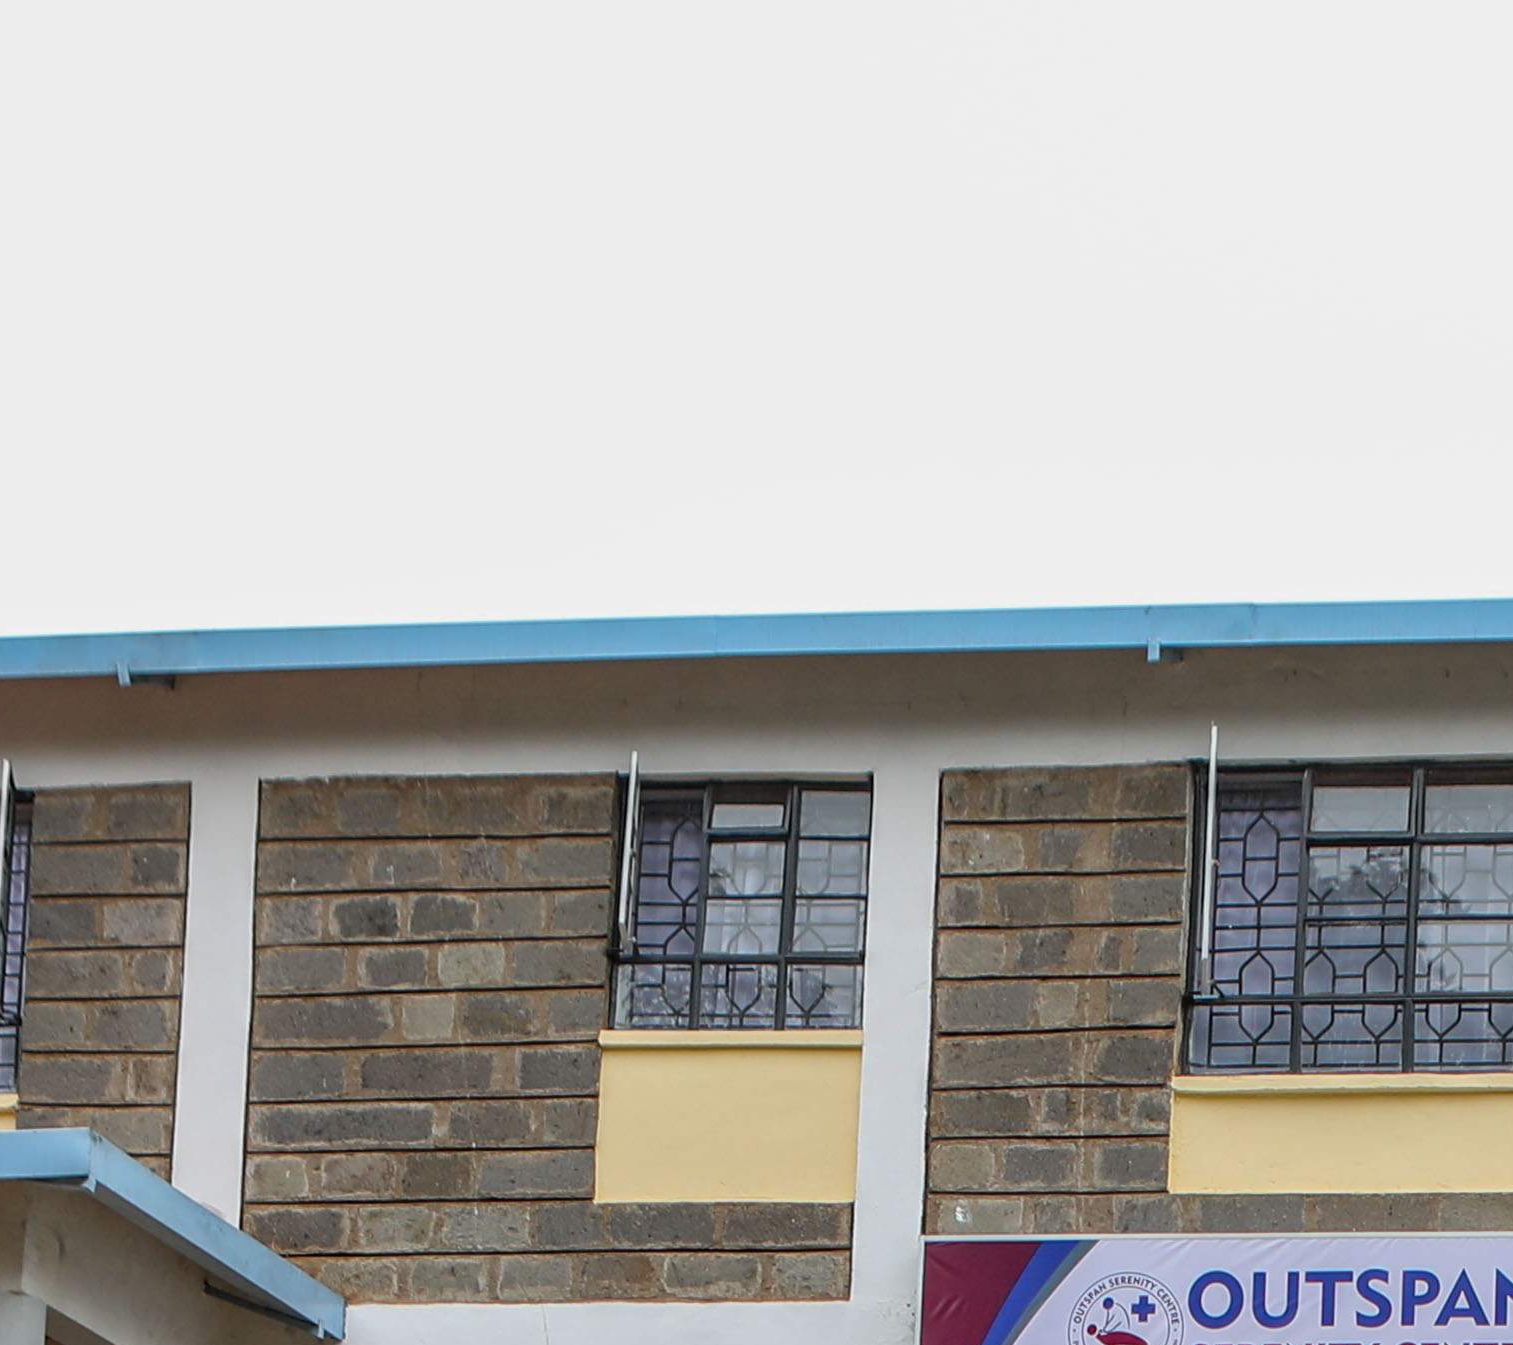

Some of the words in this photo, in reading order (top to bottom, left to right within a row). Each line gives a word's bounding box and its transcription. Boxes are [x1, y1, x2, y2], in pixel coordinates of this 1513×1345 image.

[1073, 1283, 1107, 1324] OUTSPAN
[1109, 1275, 1157, 1291] SERENITY
[1156, 1288, 1180, 1325] CENTRE
